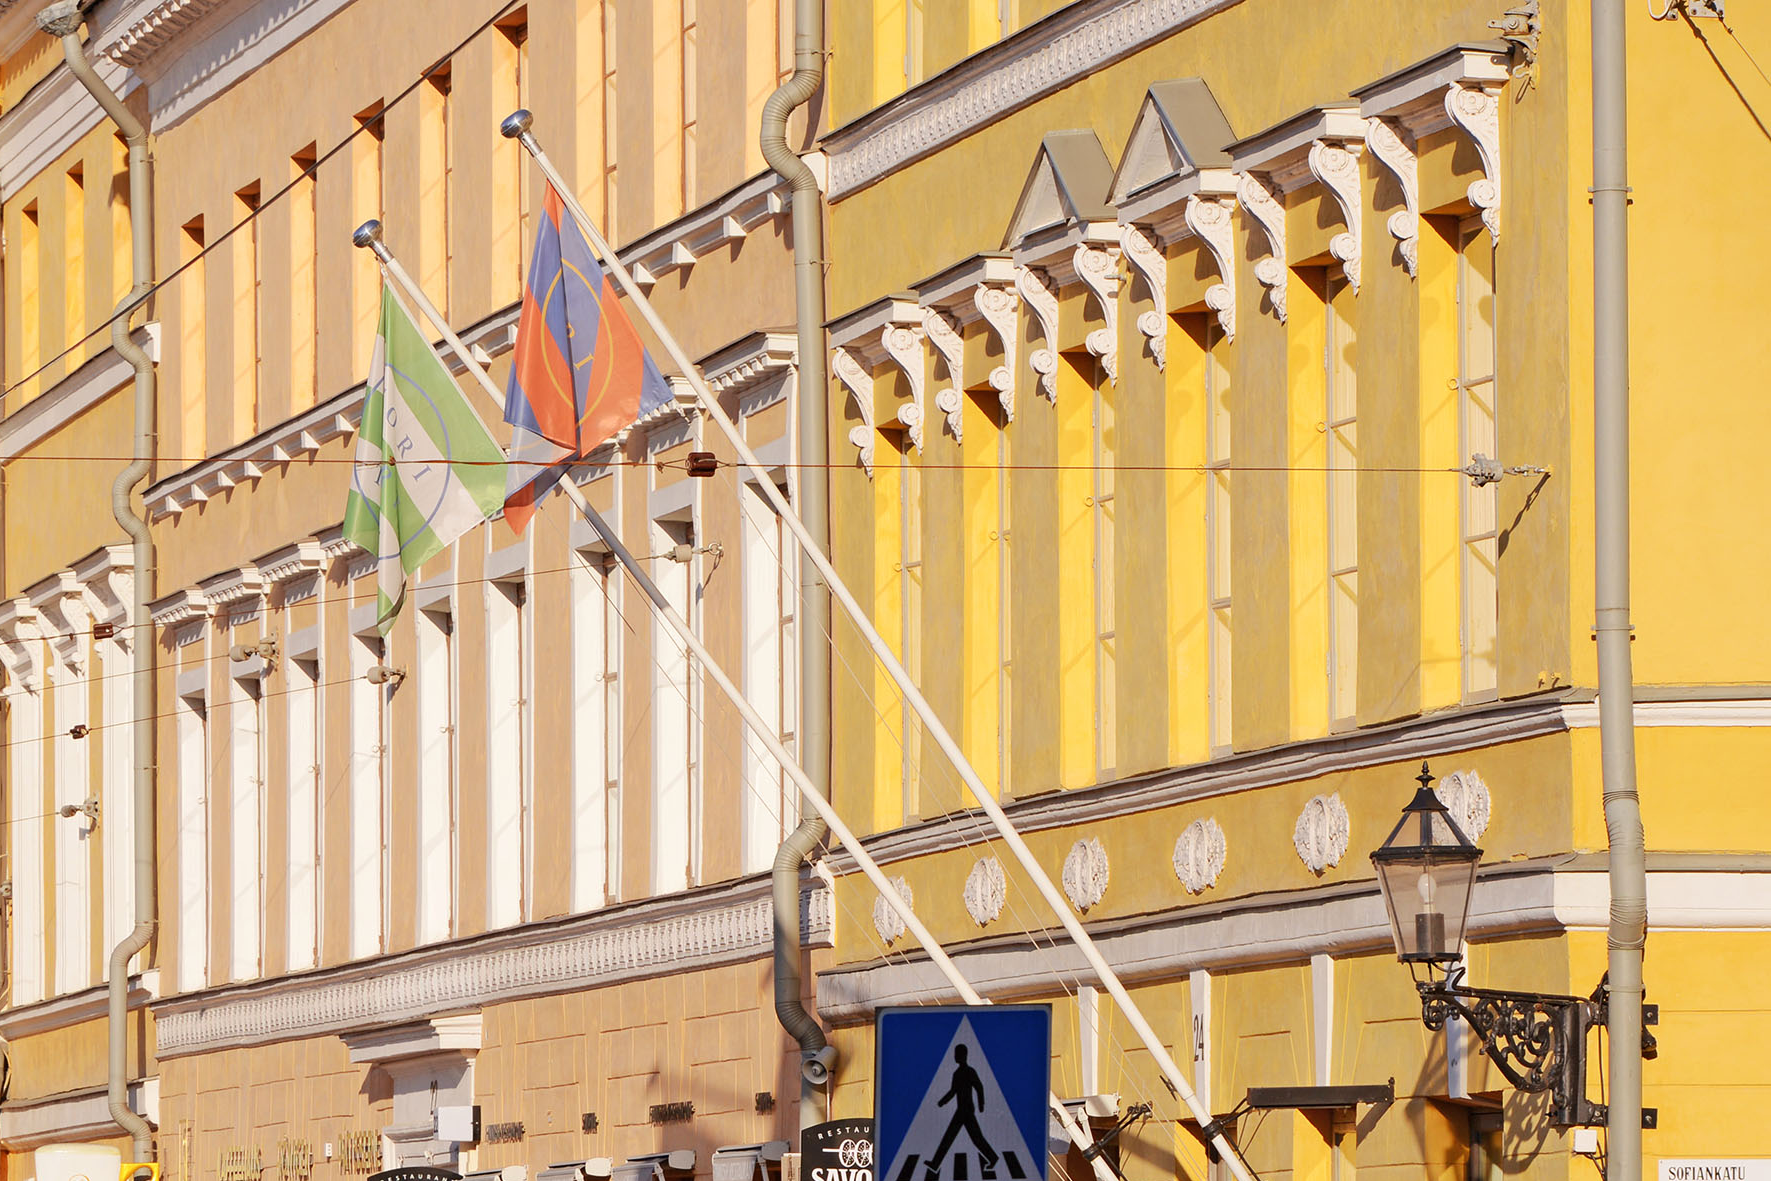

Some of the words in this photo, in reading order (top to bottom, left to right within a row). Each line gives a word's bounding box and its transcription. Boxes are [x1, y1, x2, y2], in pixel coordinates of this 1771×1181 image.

[1193, 1013, 1205, 1062] 24
[817, 1126, 870, 1140] RESTAU
[1668, 1166, 1746, 1181] SOFIANKATU
